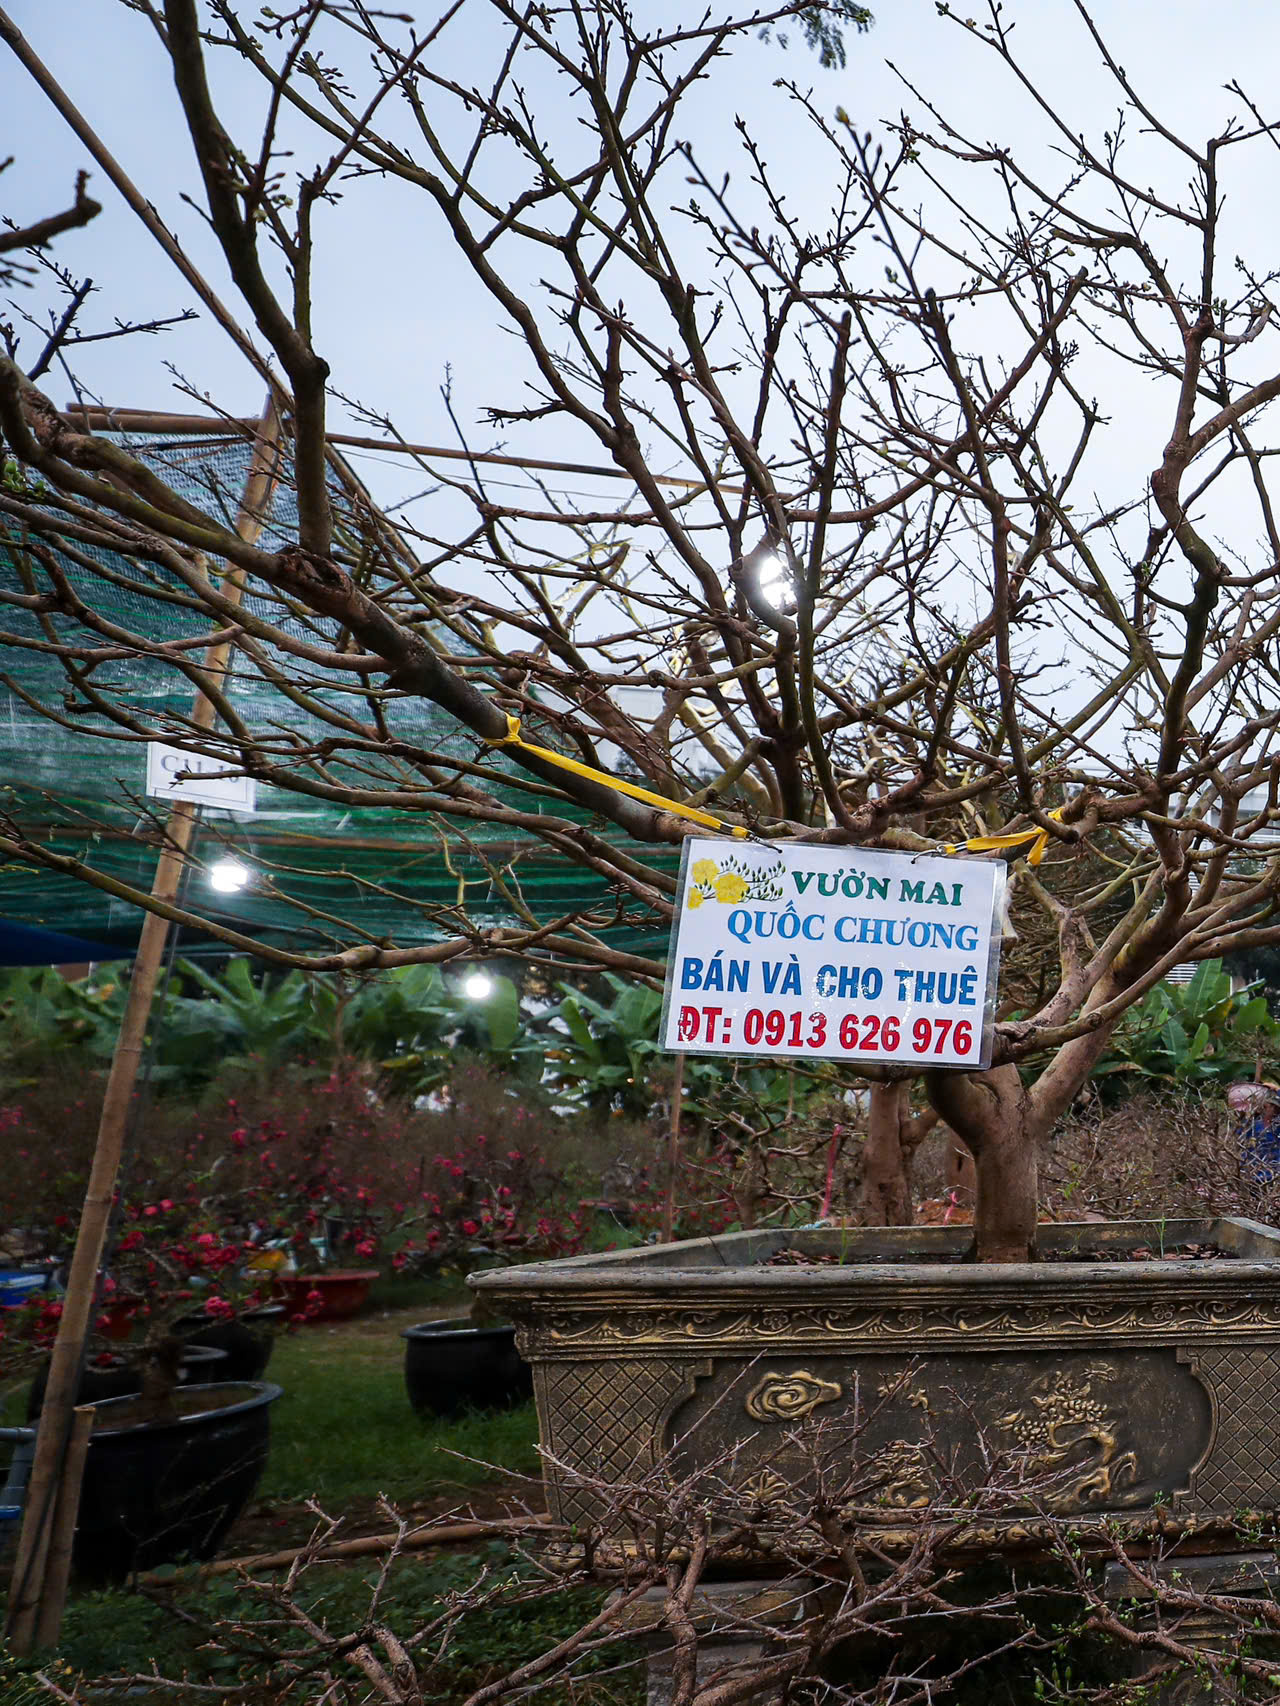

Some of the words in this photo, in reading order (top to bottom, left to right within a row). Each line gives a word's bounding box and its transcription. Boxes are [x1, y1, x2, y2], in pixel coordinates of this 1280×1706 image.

[791, 868, 890, 900] VƯỜN
[899, 879, 964, 906] MAI
[727, 900, 825, 944] QUỐC
[834, 916, 979, 951] CHƯƠNG
[681, 950, 750, 993] BÁN
[762, 953, 802, 995] VÀ
[815, 964, 883, 1000] CHO
[894, 965, 978, 1006] THUÊ
[678, 1005, 732, 1044] ĐT:
[744, 1008, 827, 1048] 0913
[839, 1013, 901, 1052] 626
[912, 1017, 973, 1055] 976
